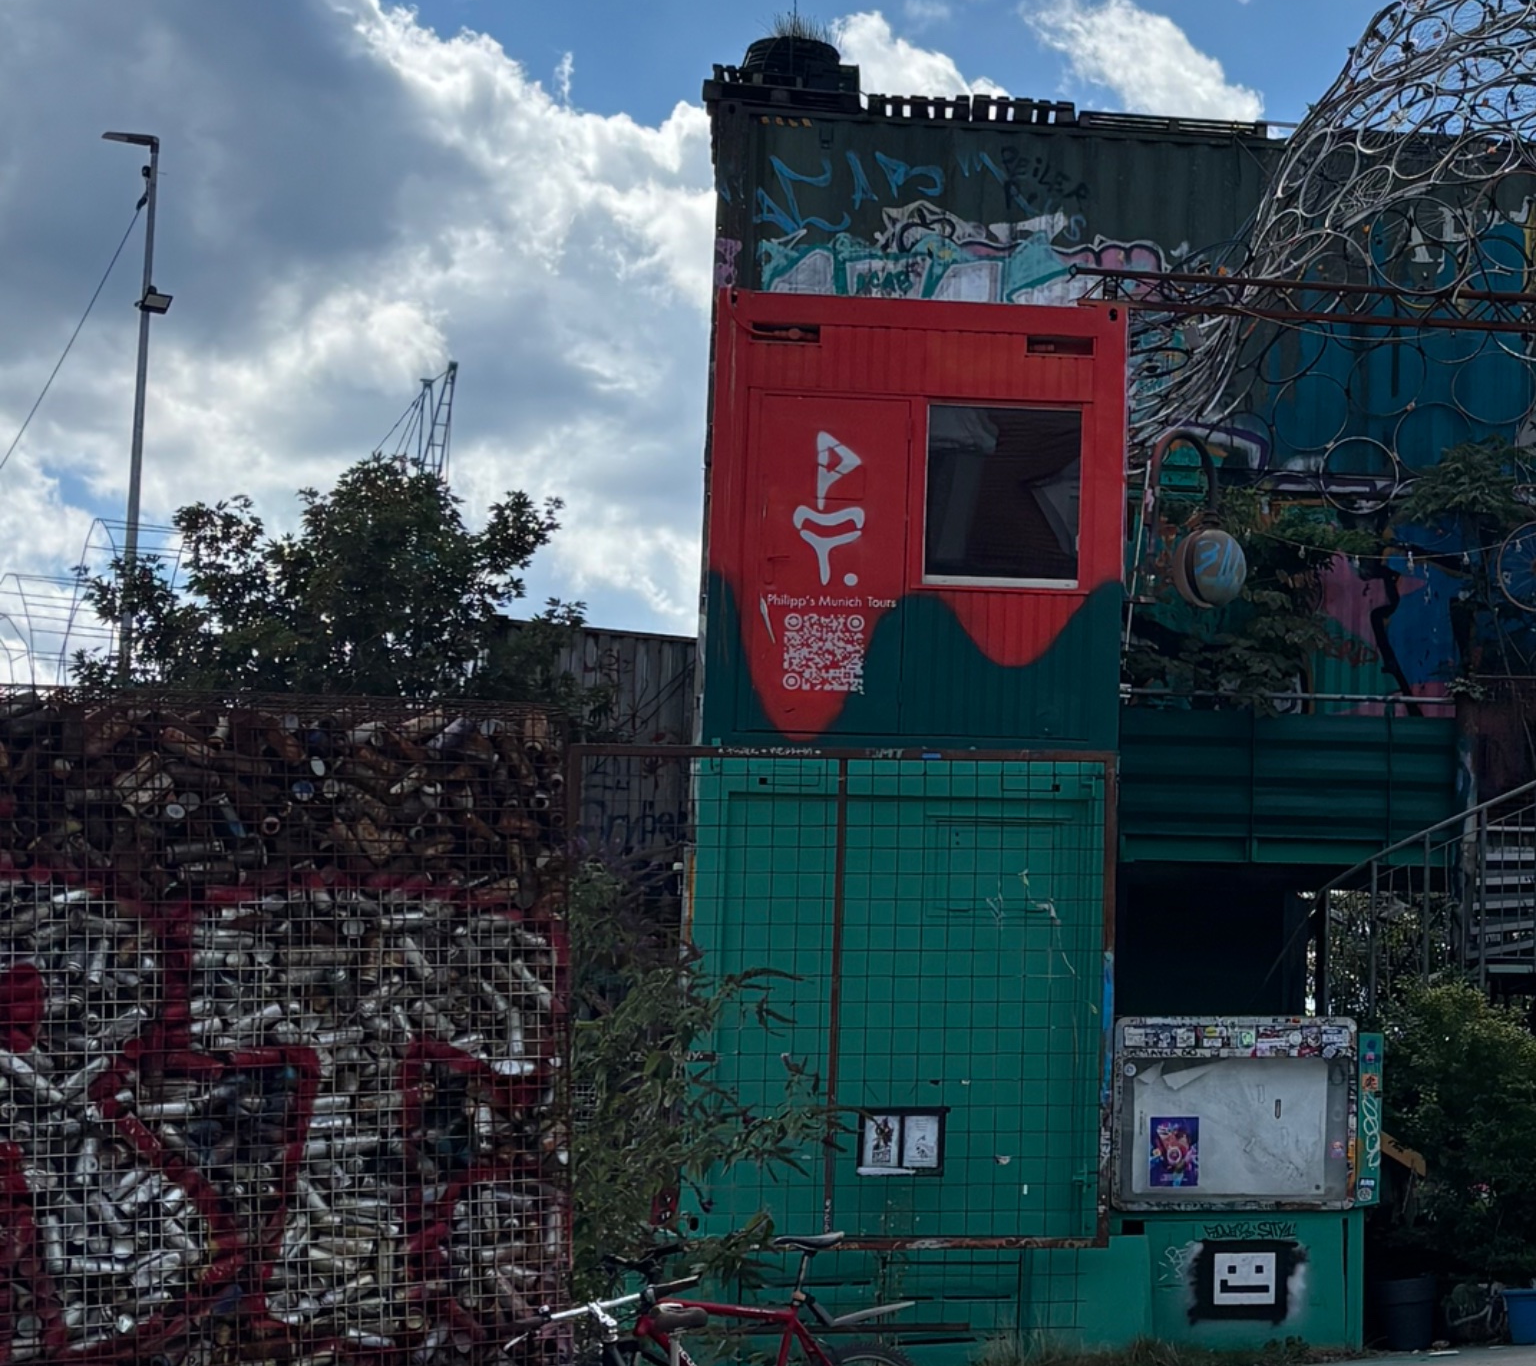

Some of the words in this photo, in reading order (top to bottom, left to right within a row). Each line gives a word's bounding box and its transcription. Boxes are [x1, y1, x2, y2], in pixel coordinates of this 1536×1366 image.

[766, 593, 815, 608] Philipp's
[818, 595, 862, 608] Munich
[866, 596, 897, 609] Tours
